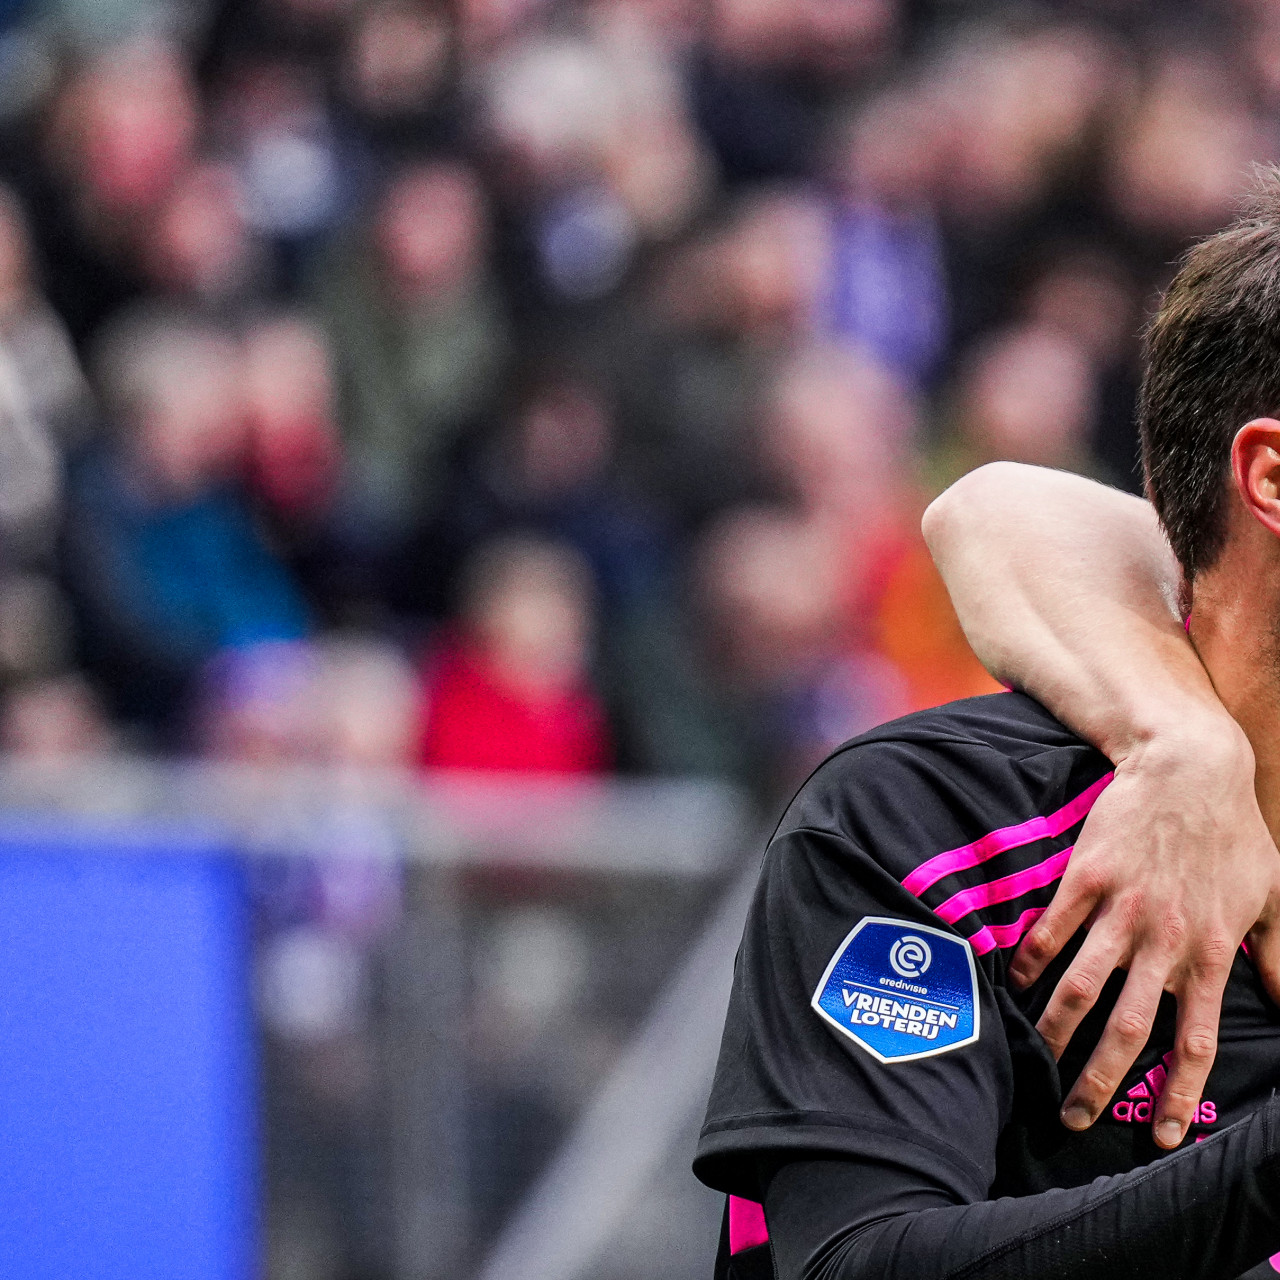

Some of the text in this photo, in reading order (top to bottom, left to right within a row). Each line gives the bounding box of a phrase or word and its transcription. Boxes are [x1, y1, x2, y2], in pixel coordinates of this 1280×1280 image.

[879, 976, 928, 995] eredivisie
[841, 987, 959, 1030] VRIENDEN
[849, 1009, 941, 1041] LOTERIJ
[1111, 1095, 1219, 1124] ads
